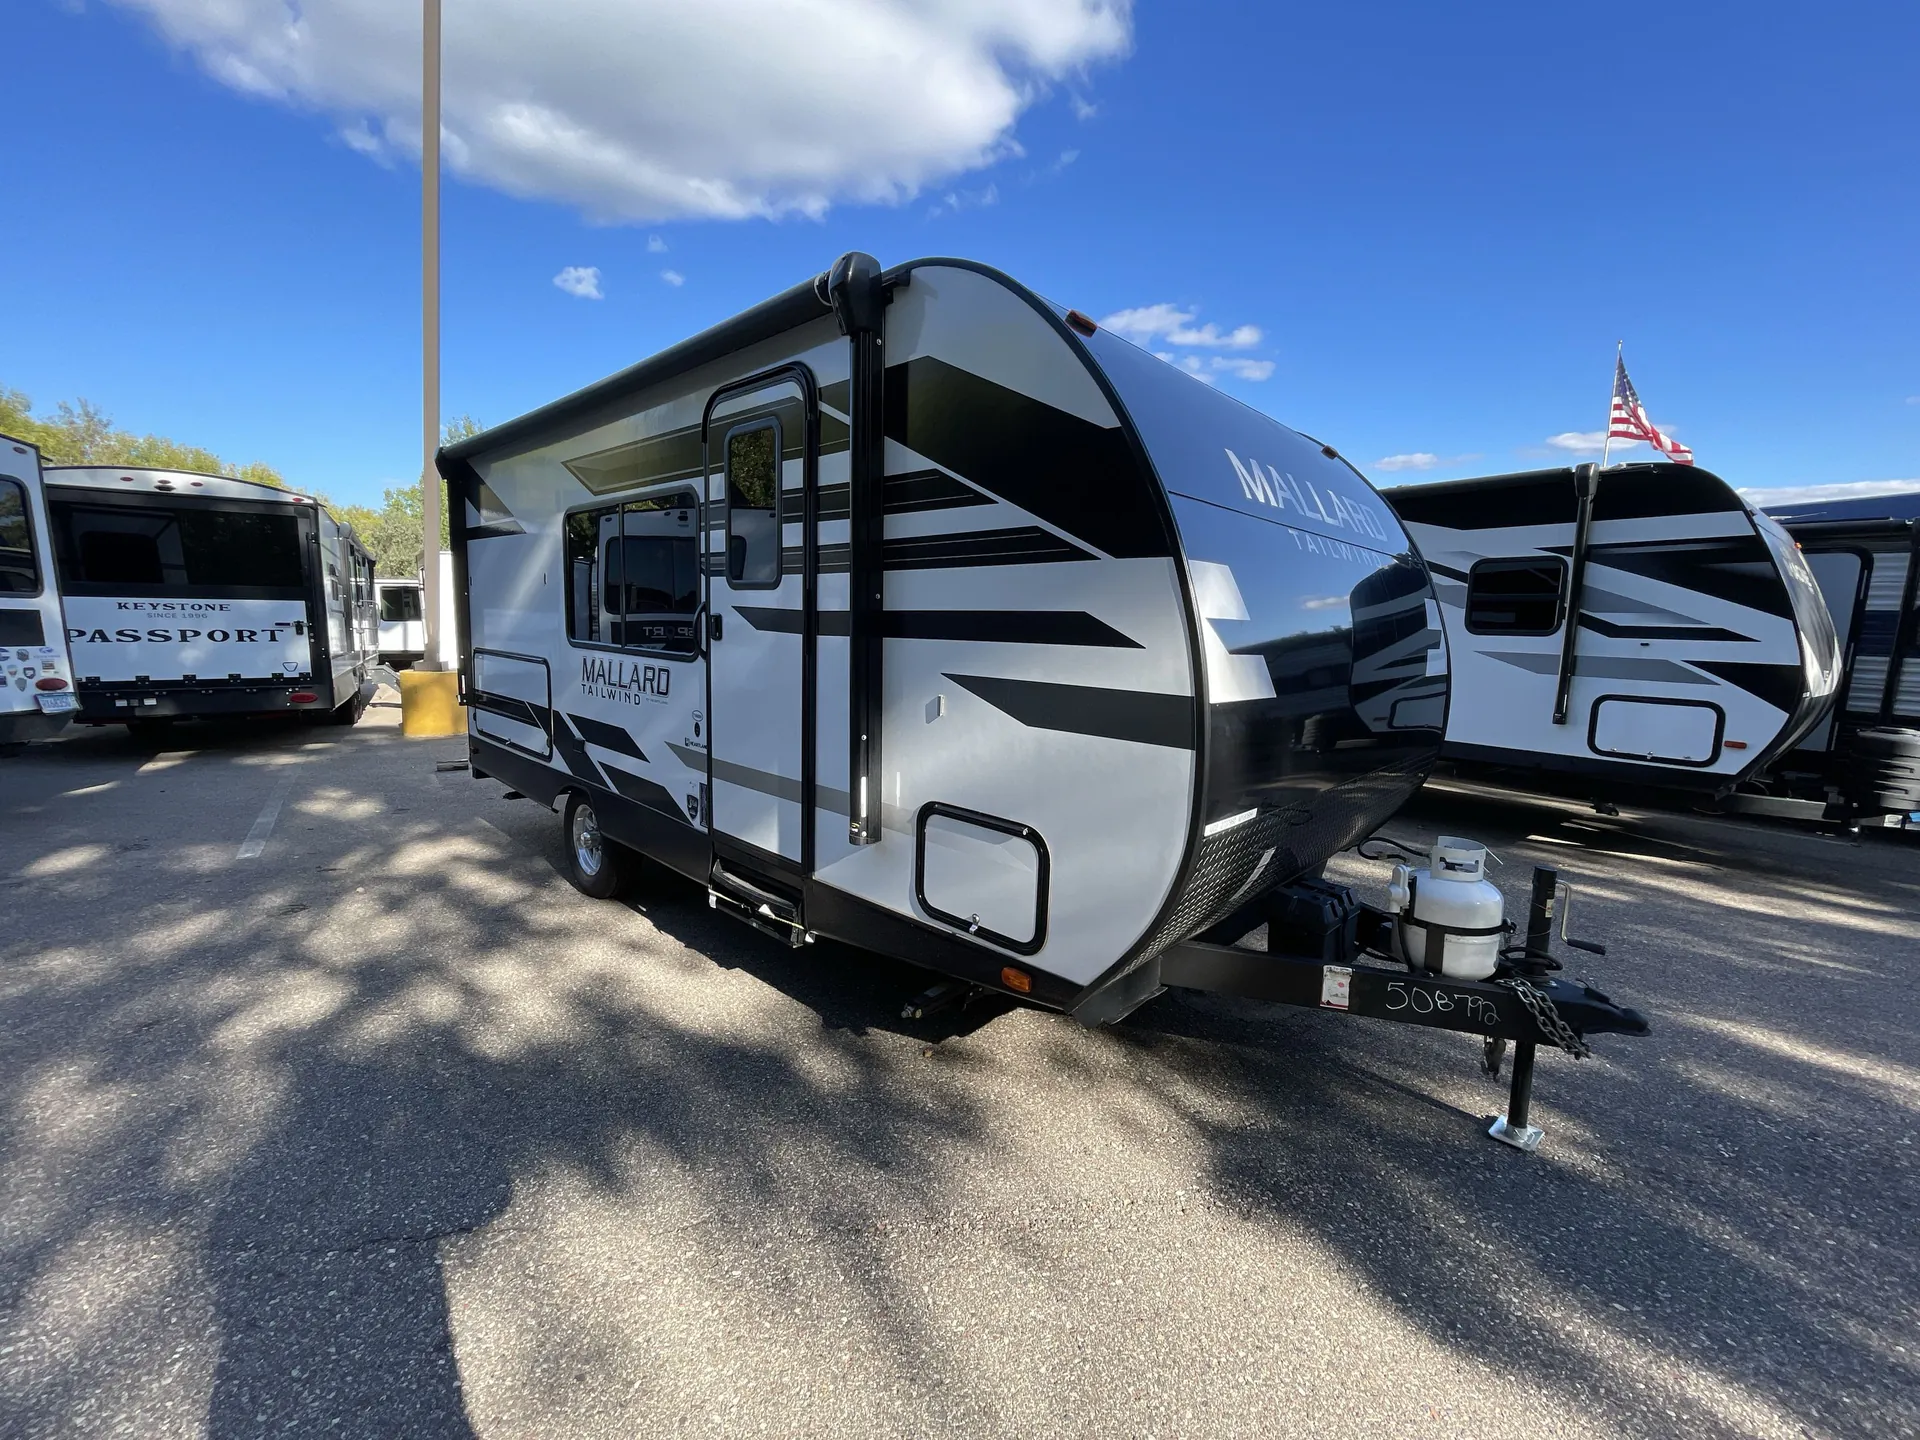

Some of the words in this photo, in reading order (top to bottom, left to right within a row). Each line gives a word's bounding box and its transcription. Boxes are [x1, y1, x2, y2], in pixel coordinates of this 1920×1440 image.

[1224, 447, 1388, 542] MALLARD
[1288, 528, 1382, 567] TAILWIND
[116, 602, 231, 612] KEYSTONE
[67, 628, 284, 643] PASSPORT
[581, 683, 641, 706] TAILWIND
[582, 656, 671, 698] MALLARD
[1385, 982, 1501, 1025] 508792
